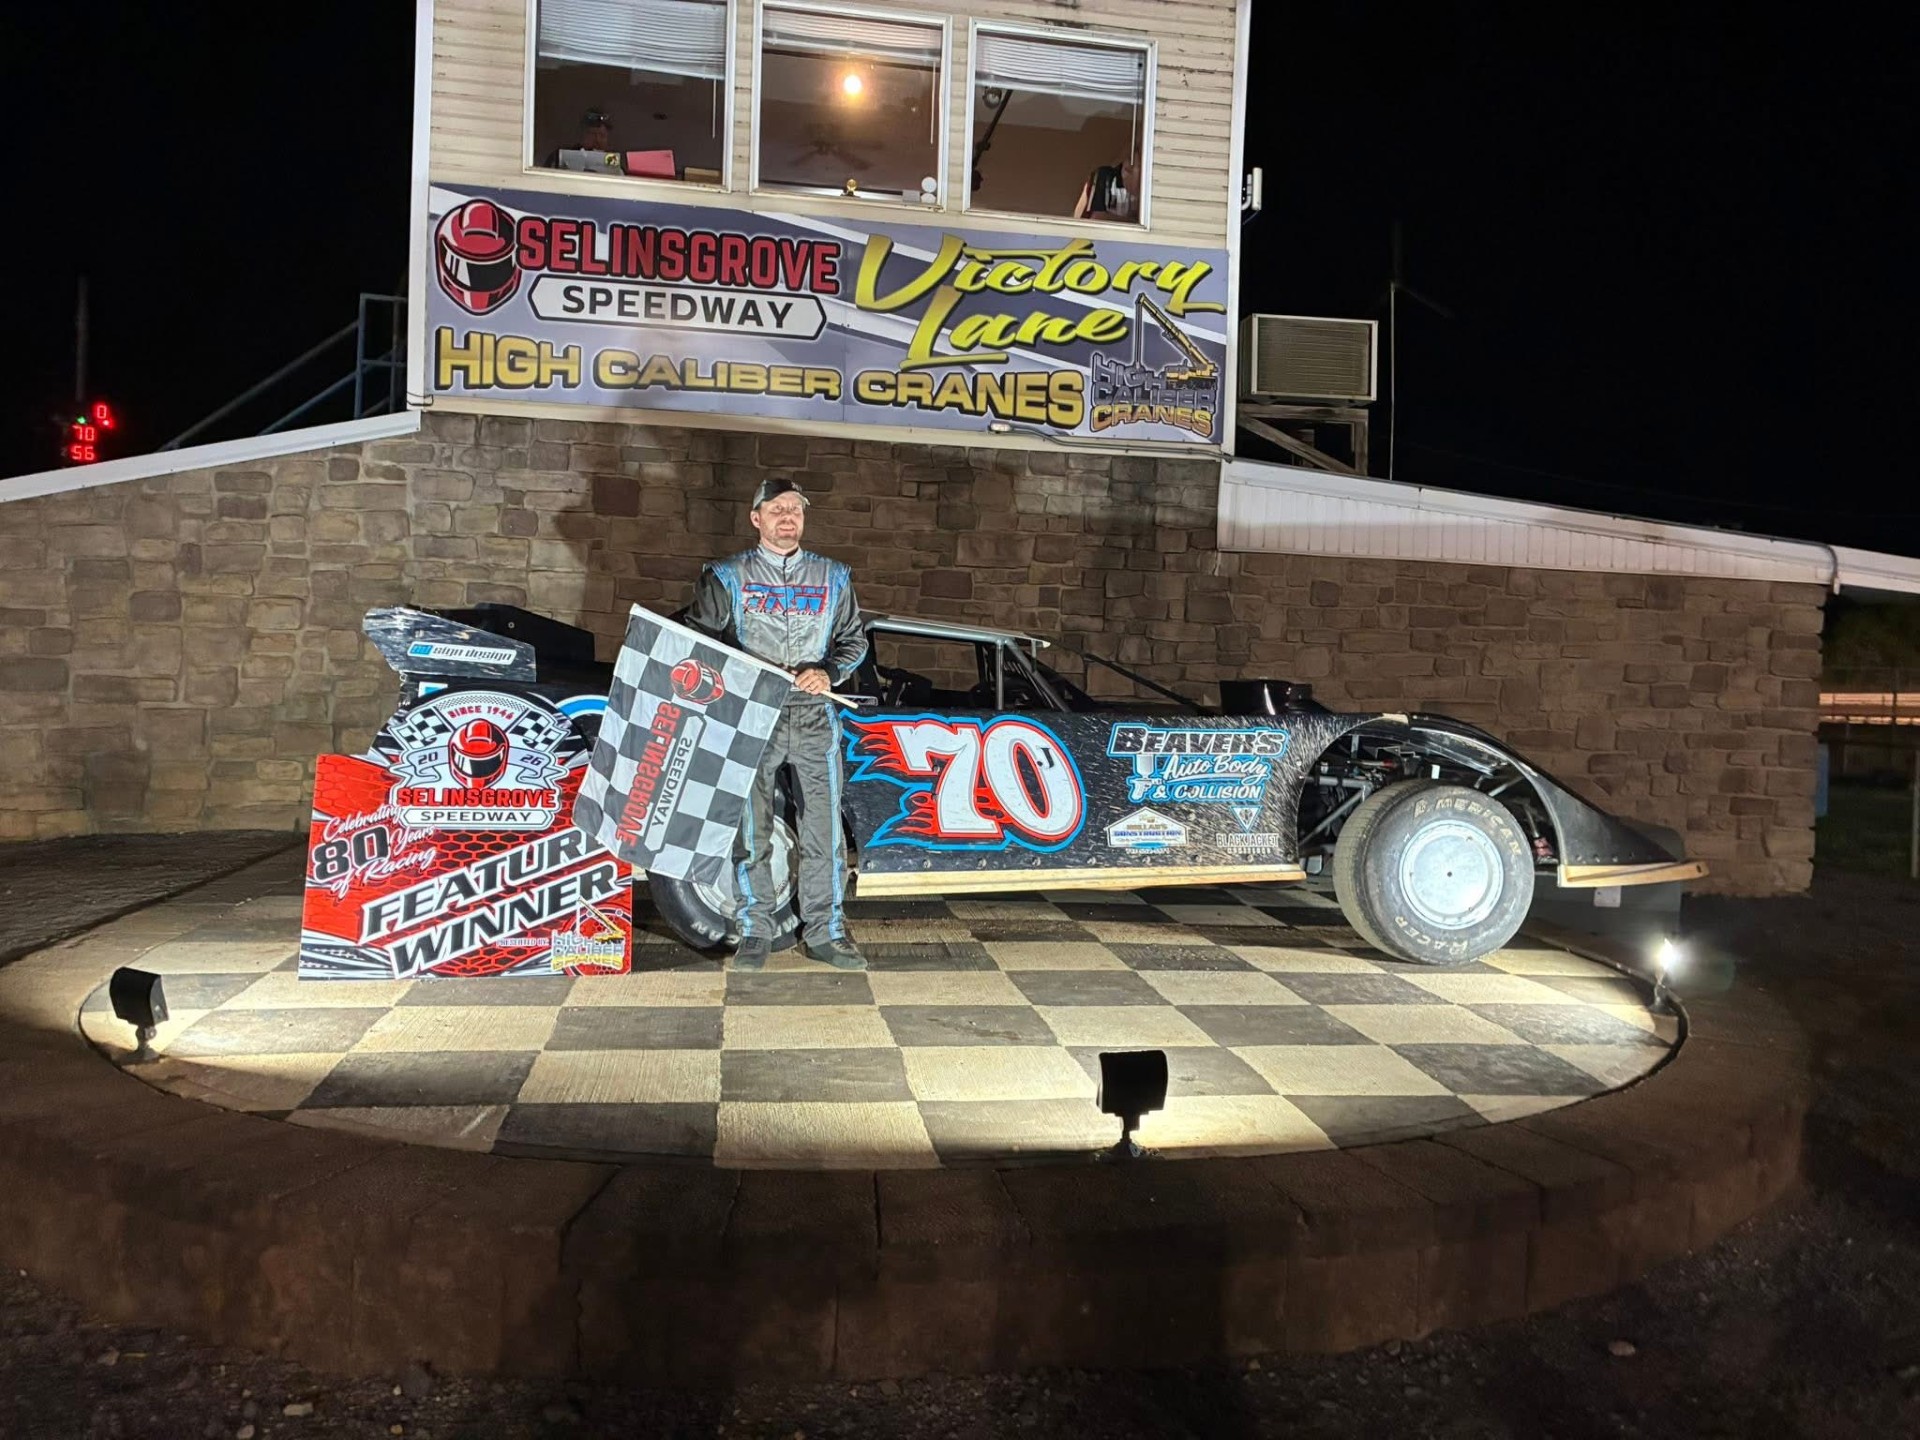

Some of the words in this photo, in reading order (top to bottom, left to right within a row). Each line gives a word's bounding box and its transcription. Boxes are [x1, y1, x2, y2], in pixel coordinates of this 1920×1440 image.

[515, 216, 842, 295] SELINSGROVE
[856, 234, 1227, 317] Victory
[562, 286, 793, 329] SPEEDWAY
[900, 285, 1128, 371] Lane
[435, 327, 582, 391] HIGH
[594, 348, 842, 400] CALIBER
[855, 369, 1085, 428] CRANES
[1093, 352, 1167, 391] HIGH
[72, 425, 95, 441] 70
[1090, 404, 1213, 438] CRANES
[71, 445, 95, 461] 56
[448, 706, 481, 719] SINCE
[487, 706, 515, 720] 1946
[1110, 725, 1286, 755] BEAVER'S
[418, 752, 438, 765] 20
[520, 754, 545, 766] 26
[1162, 754, 1213, 780] Auto
[1213, 754, 1269, 785] Body
[397, 787, 556, 808] SELINSGROVE
[891, 719, 1082, 841] 70
[1153, 786, 1168, 799] &
[1175, 785, 1262, 800] COLLISION
[323, 803, 402, 841] Celebrating
[421, 811, 531, 822] SPEEDWAY
[313, 825, 390, 882] 80
[390, 826, 436, 855] Years
[331, 868, 354, 901] of
[355, 847, 436, 885] Racing
[388, 862, 619, 977] WINNER
